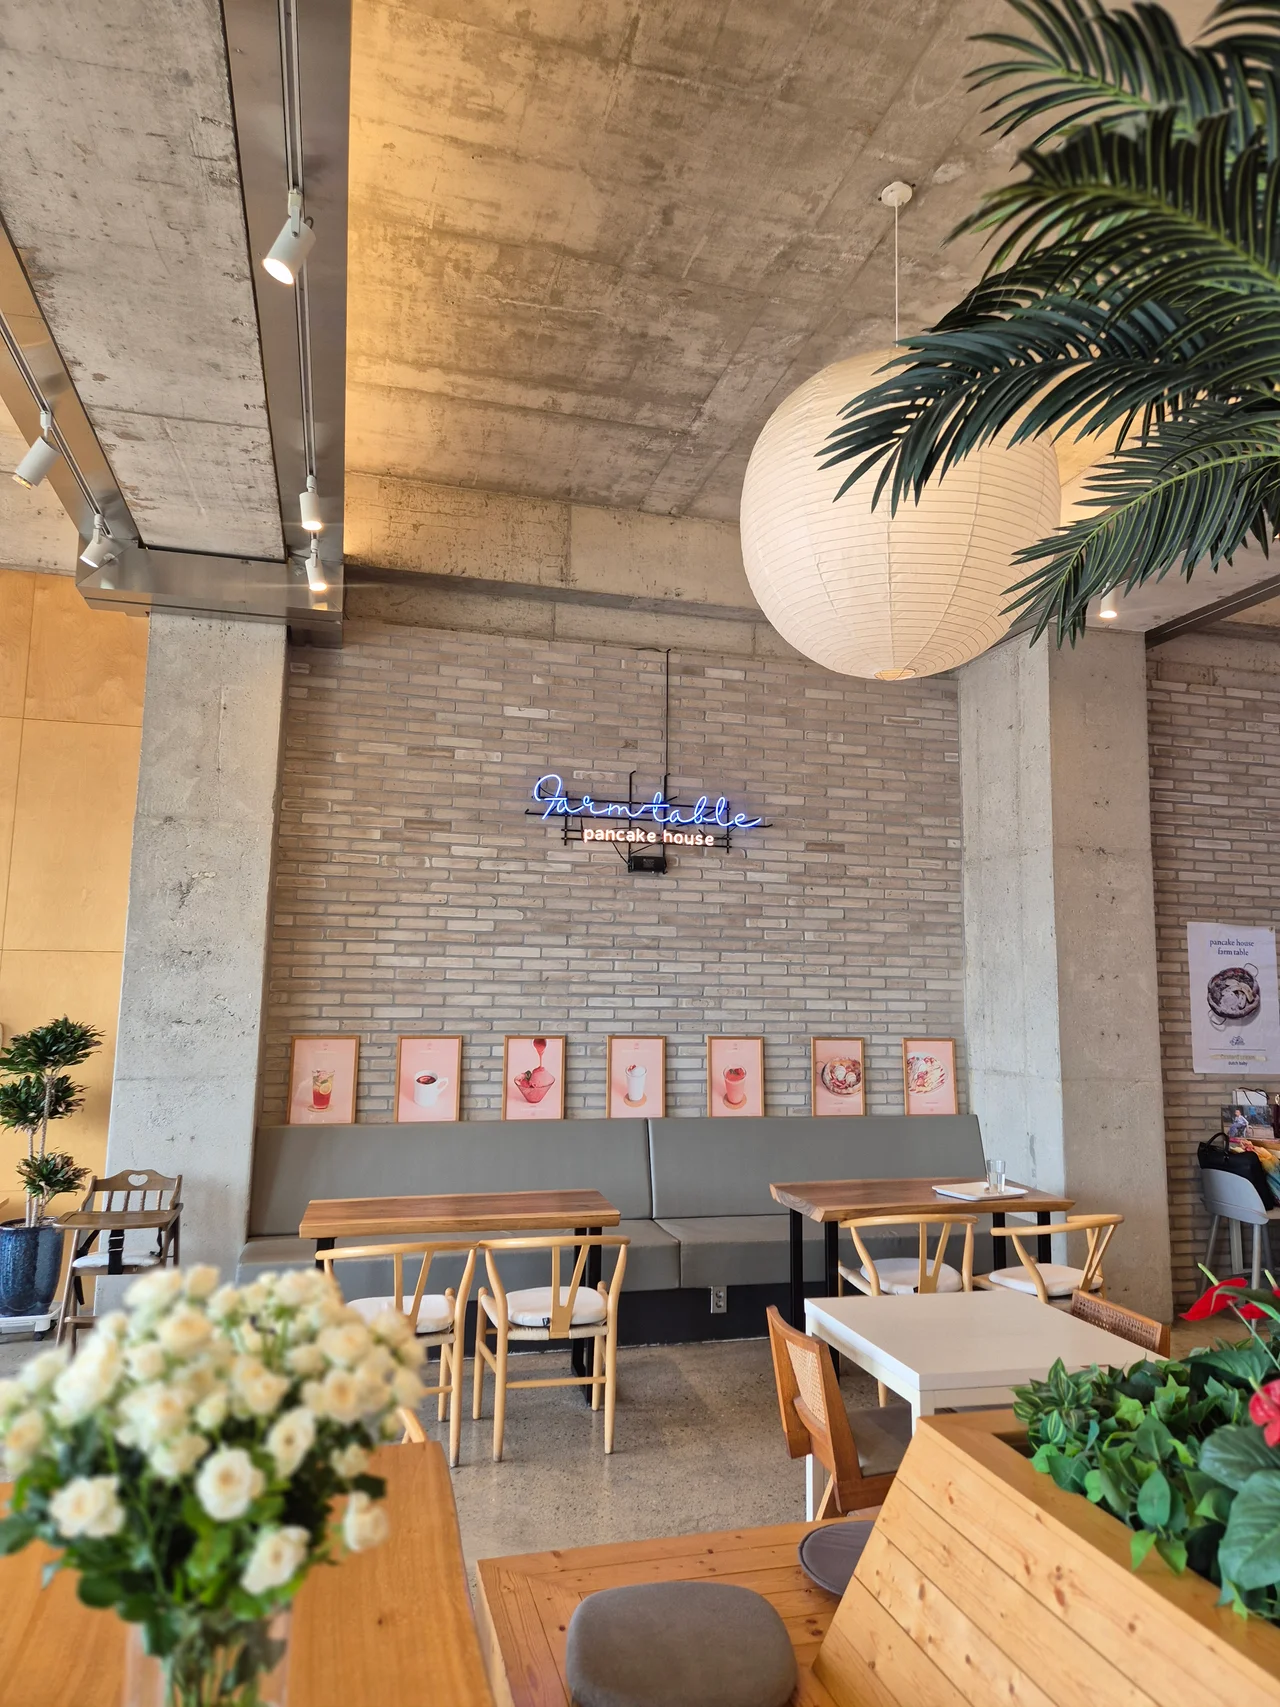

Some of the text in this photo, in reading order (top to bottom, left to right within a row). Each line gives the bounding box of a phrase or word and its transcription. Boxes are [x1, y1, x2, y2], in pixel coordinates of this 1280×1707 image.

[582, 828, 715, 846] pancake house
[1209, 938, 1254, 948] pancake house
[1217, 947, 1249, 956] farm table
